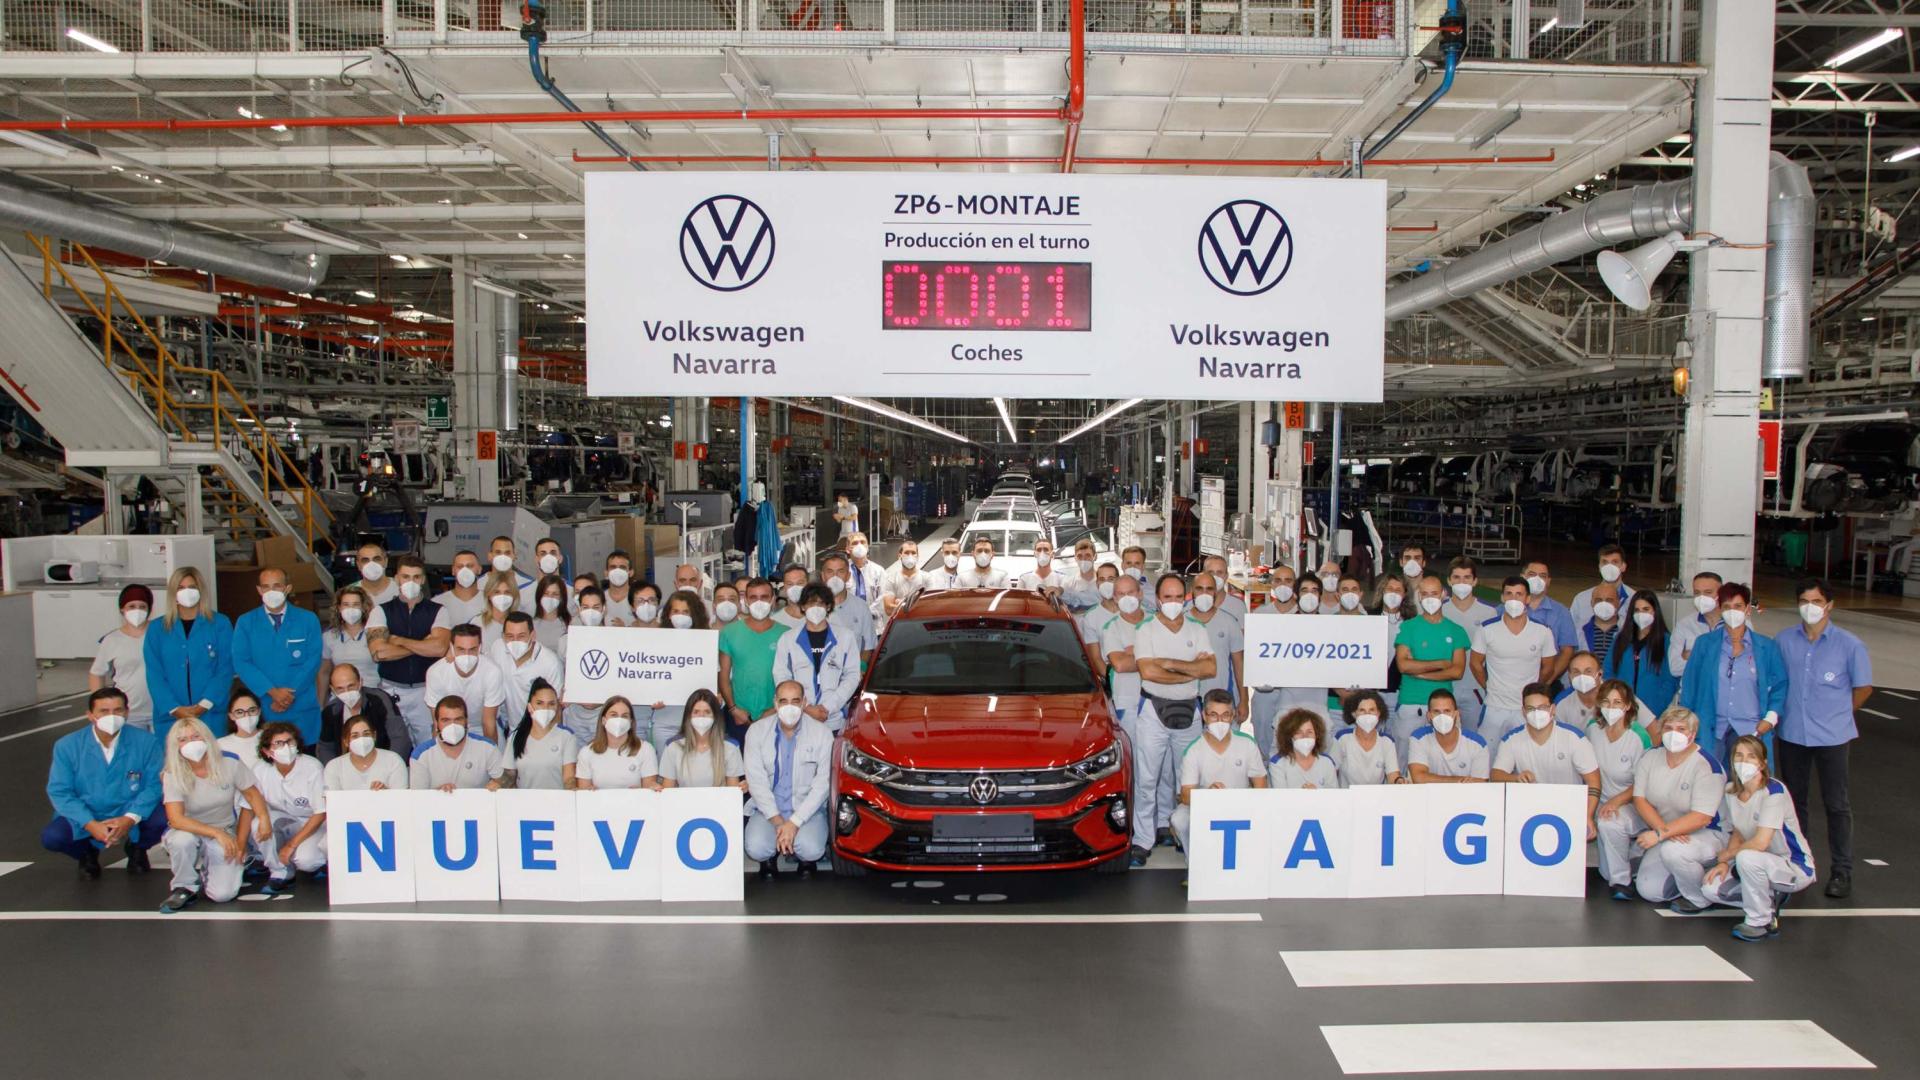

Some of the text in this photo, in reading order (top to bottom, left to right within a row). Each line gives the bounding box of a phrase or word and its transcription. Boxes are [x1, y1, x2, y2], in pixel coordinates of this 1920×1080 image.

[894, 195, 1080, 215] ZP6-MONTAJE
[885, 233, 1090, 250] Producción en el turno
[885, 265, 1072, 326] 0001
[643, 321, 804, 347] Volkswagen
[1170, 325, 1329, 352] Volkswagen
[951, 344, 1023, 361] Coches
[673, 353, 777, 375] Navarra
[1199, 357, 1302, 379] Navarra
[1289, 415, 1301, 427] 61
[482, 433, 491, 446] C
[481, 447, 493, 459] 61
[618, 651, 703, 668] Volkswagen
[1259, 643, 1373, 660] 27/09/2021
[618, 667, 672, 680] Navarra
